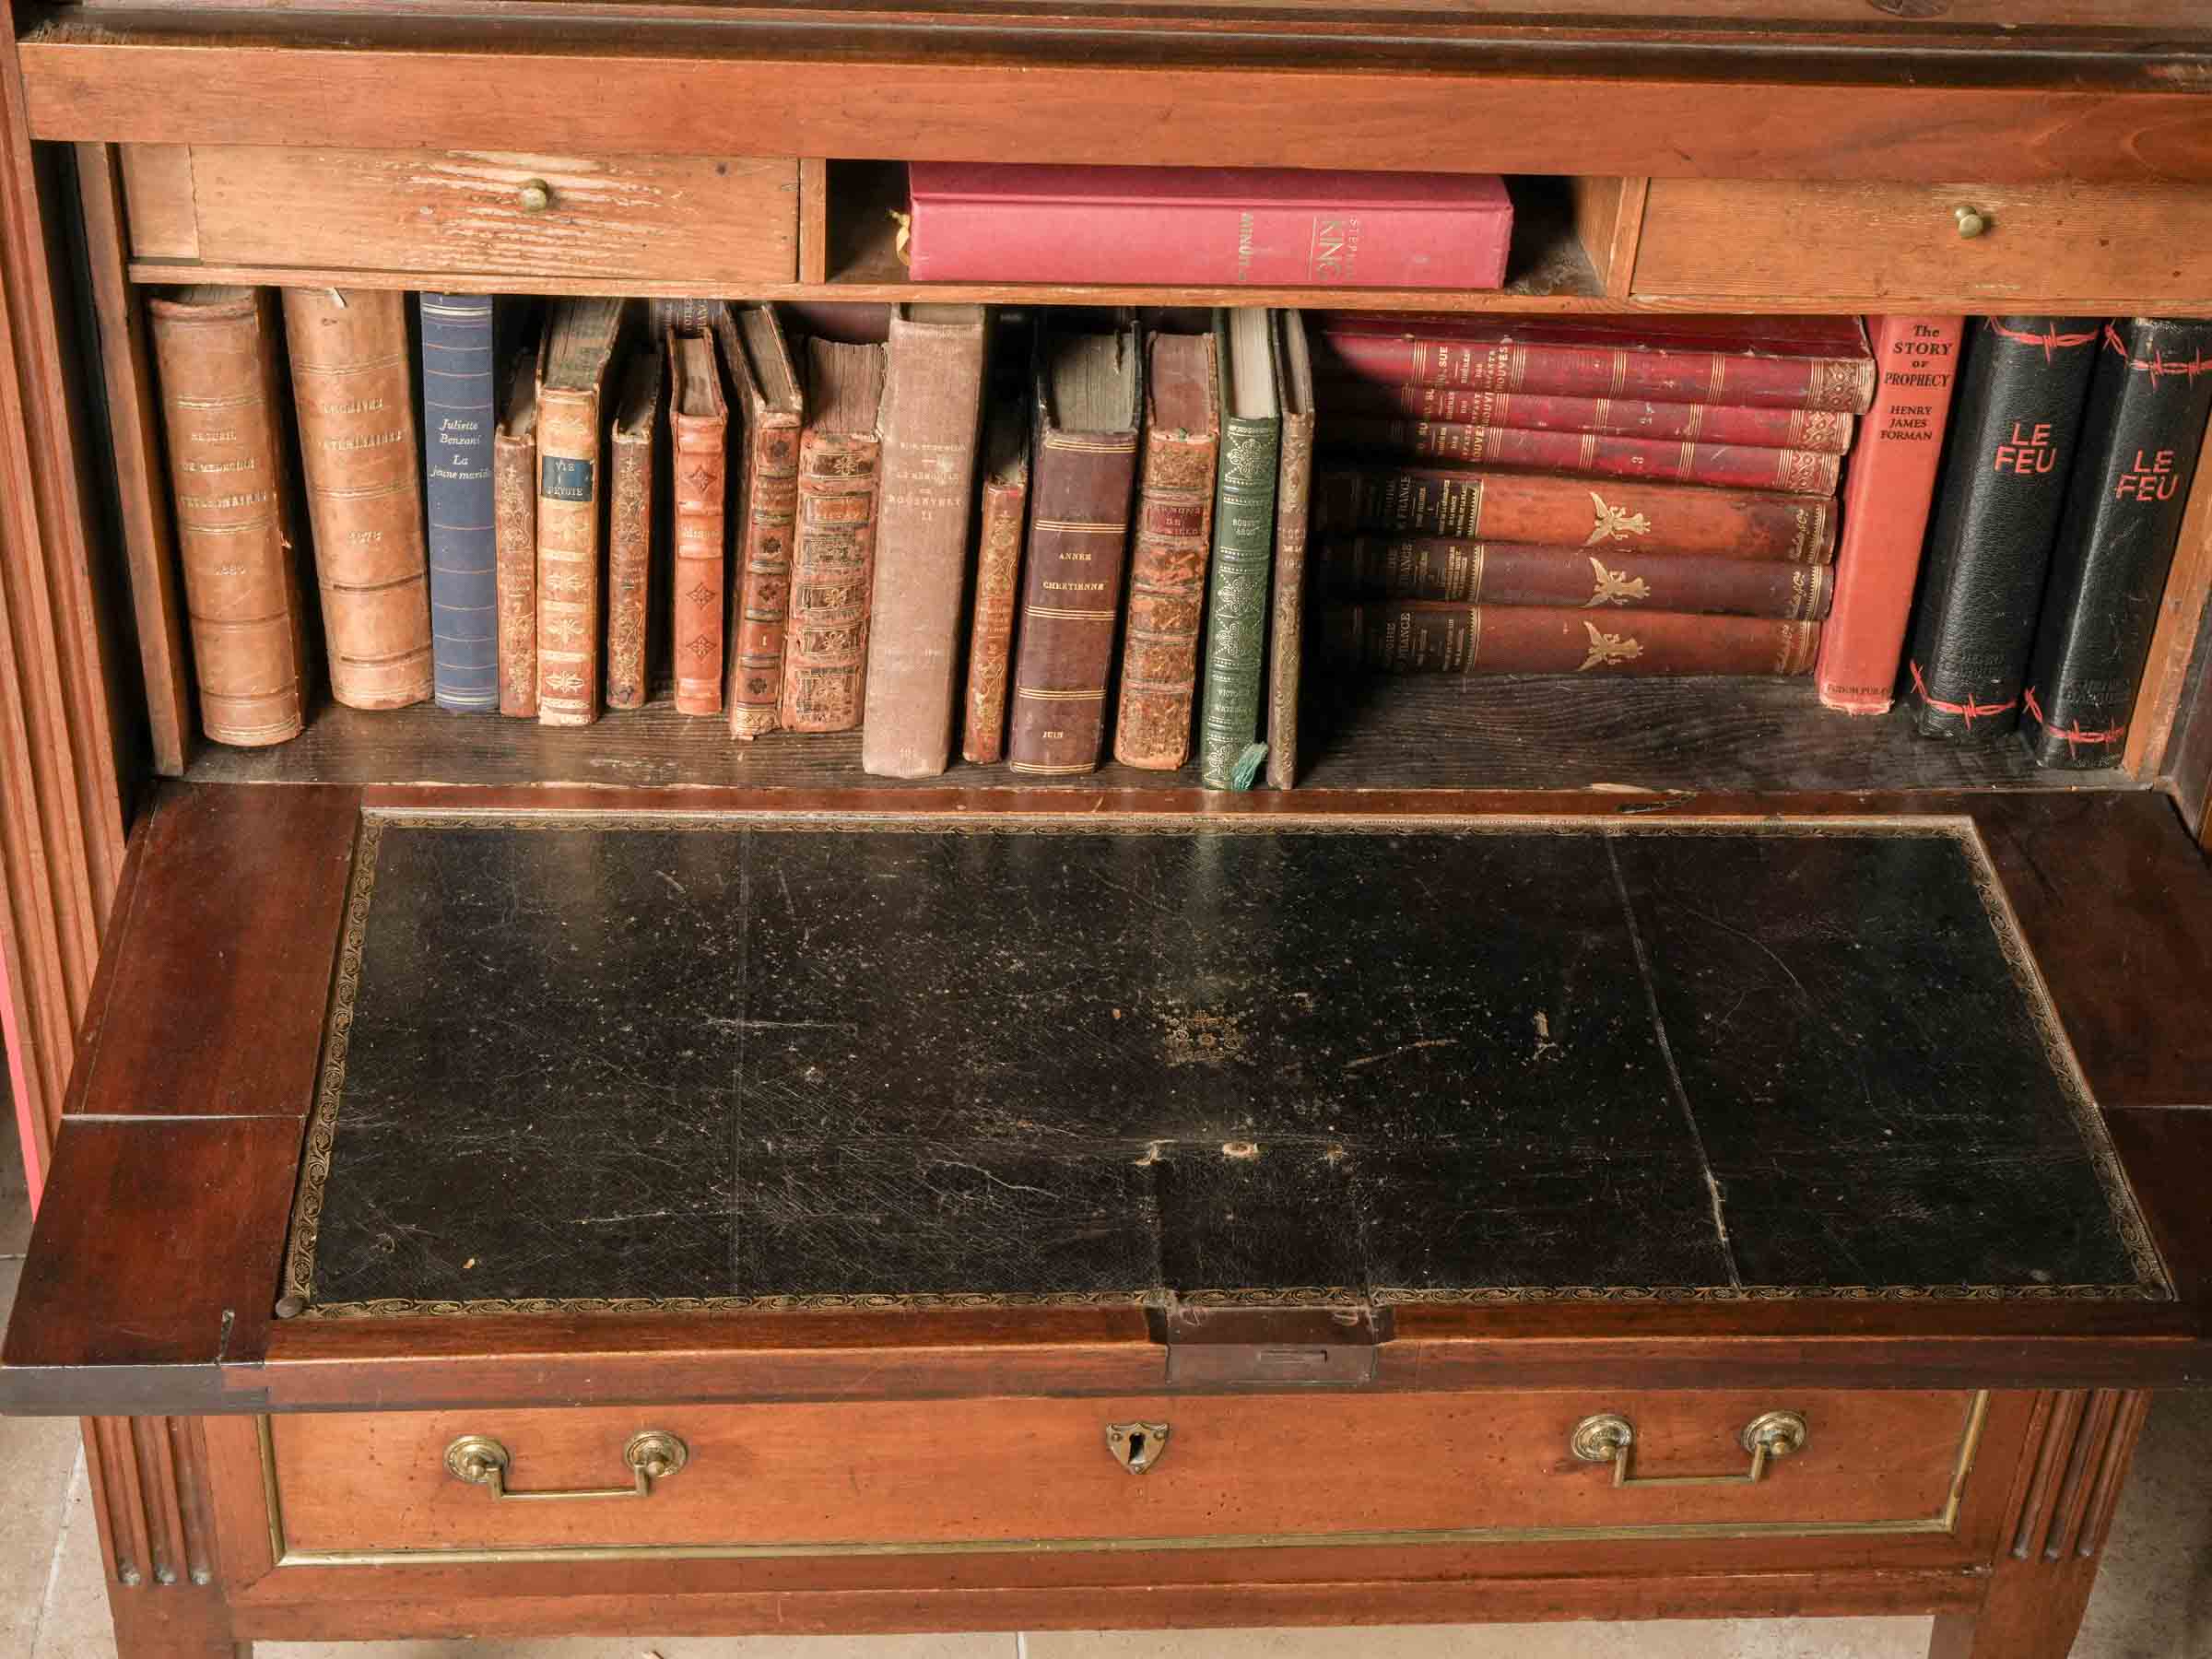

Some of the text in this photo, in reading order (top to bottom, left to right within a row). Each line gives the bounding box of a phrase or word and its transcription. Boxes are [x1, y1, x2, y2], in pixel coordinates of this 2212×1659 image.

[1315, 219, 1345, 280] KING
[1912, 324, 1940, 337] The
[1893, 341, 1953, 356] STORY
[1438, 346, 1448, 368] SUE
[1884, 371, 1951, 388] PROPHECY
[1890, 405, 1933, 415] HENRY
[438, 418, 479, 431] Juliette
[1888, 418, 1927, 429] JAMES
[440, 433, 481, 446] Benzoni
[1880, 430, 1933, 441] FORMAN
[2012, 422, 2052, 446] LE
[452, 454, 469, 465] La
[1994, 444, 2058, 474] FEU
[2133, 450, 2175, 473] LE
[555, 461, 575, 472] VIE
[2115, 474, 2180, 502] FEU
